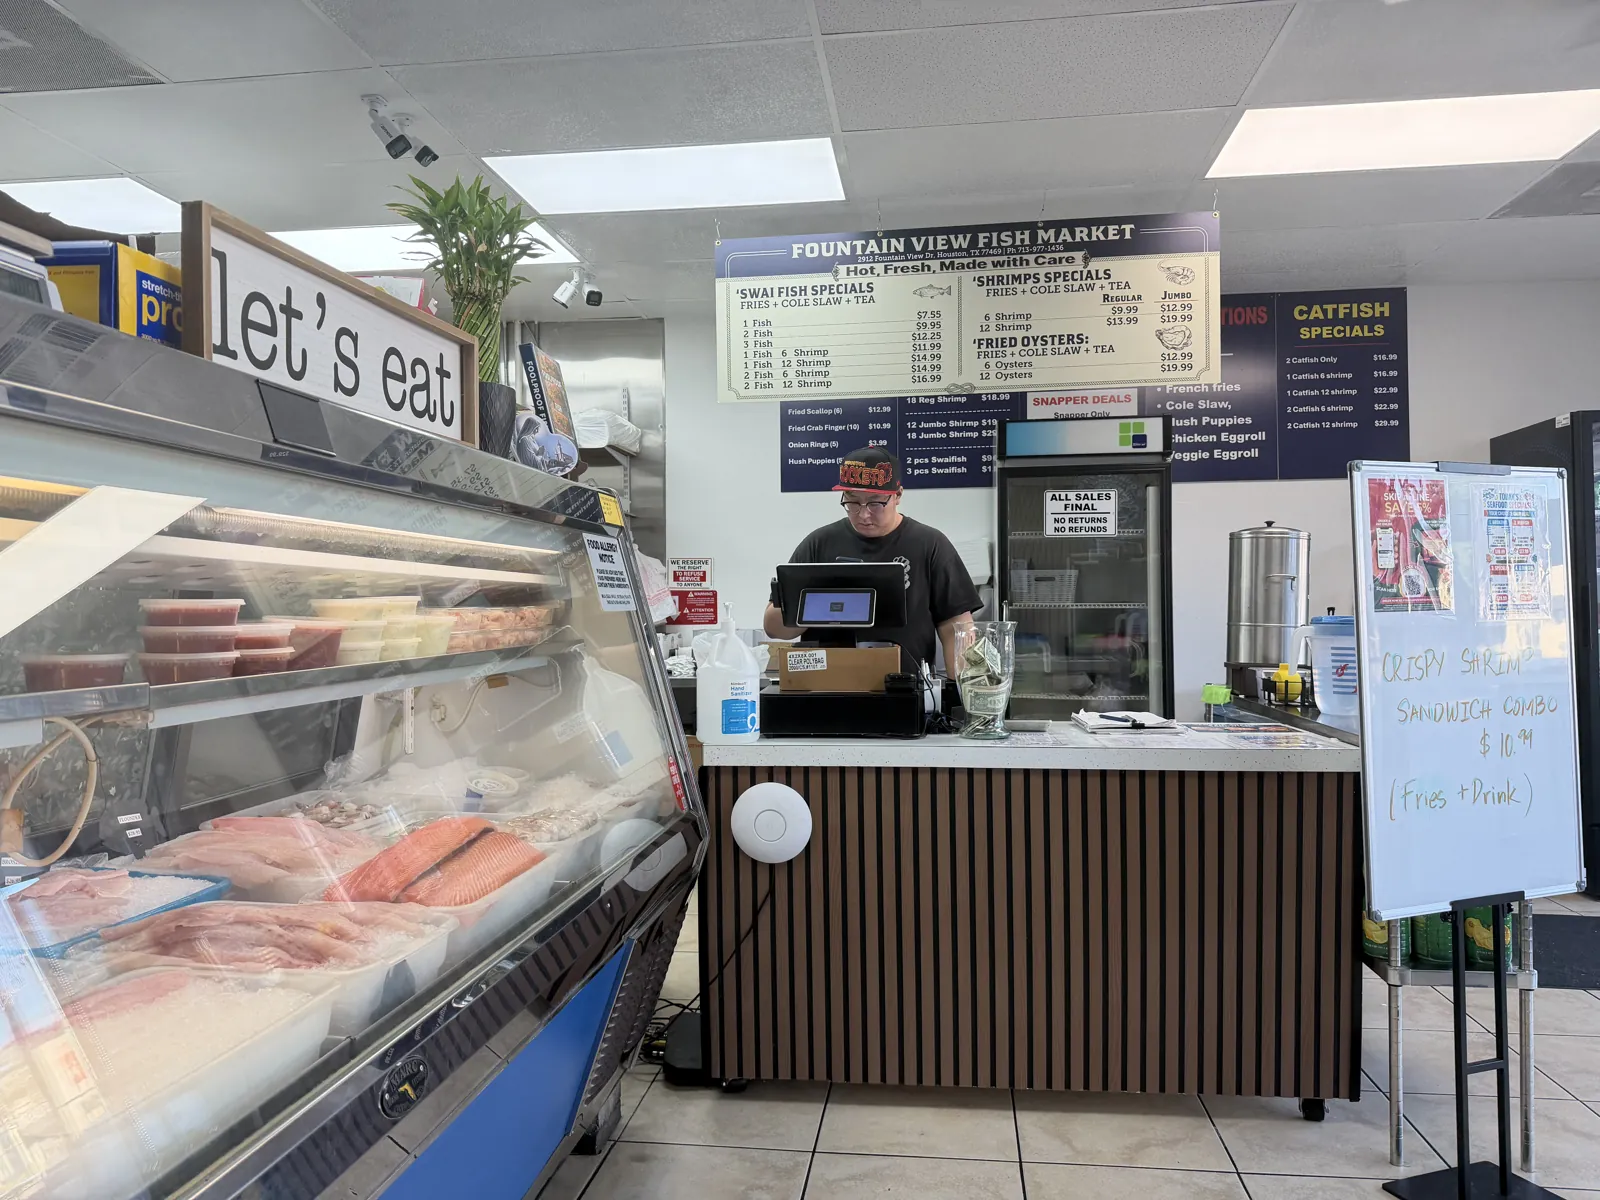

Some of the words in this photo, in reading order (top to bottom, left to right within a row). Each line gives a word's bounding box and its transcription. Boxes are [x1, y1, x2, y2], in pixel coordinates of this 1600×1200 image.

[792, 238, 905, 258] FOUNTAIN
[910, 233, 972, 251] VIEW
[978, 229, 1032, 248] FISH
[1037, 224, 1136, 245] MARKET
[1018, 245, 1064, 253] 713-977-1436
[846, 266, 880, 277] Hot,
[884, 263, 936, 275] Fresh,
[940, 260, 987, 271] Made
[992, 258, 1031, 268] with
[1034, 254, 1076, 266] Care
[1044, 269, 1112, 283] SPECIALS
[778, 286, 807, 298] FISH
[811, 282, 874, 296] SPECIALS
[986, 288, 1018, 298] FRIES
[1030, 285, 1061, 295] COLE
[1064, 284, 1096, 292] SLAW
[1108, 282, 1131, 290] TEA
[741, 301, 769, 309] FRIES
[782, 298, 810, 307] COLE
[813, 297, 842, 306] SLAW
[856, 296, 875, 304] TEA
[753, 319, 772, 327] Fish
[917, 311, 941, 319] $7.55
[995, 312, 1032, 321] Shrimp
[1111, 306, 1138, 315] $9.99
[1160, 303, 1192, 312] $12.99
[1293, 302, 1390, 320] CATFISH
[754, 329, 773, 337] Fish
[916, 321, 941, 330] $9.95
[995, 322, 1032, 332] Shrimp
[1106, 317, 1138, 326] $13.99
[1160, 314, 1192, 323] $19.99
[211, 246, 359, 397] let's
[382, 346, 455, 428] eat
[1300, 324, 1385, 339] SPECIALS
[1022, 333, 1089, 347] OYSTERS:
[754, 350, 772, 358] Fish
[794, 348, 829, 358] Shrimp
[912, 342, 942, 351] $11.99
[977, 350, 1007, 359] FRIES
[1018, 348, 1048, 357] COLE
[1051, 347, 1081, 355] SLAW
[1093, 345, 1115, 353] TEA
[995, 360, 1033, 369] Oysters
[1160, 352, 1193, 362] $12.99
[995, 371, 1033, 381] Oysters
[1160, 363, 1193, 373] $19.99
[526, 361, 544, 410] FOOLPROOF
[754, 381, 774, 390] Fish
[797, 379, 832, 389] Shrimp
[911, 374, 942, 384] $16.99
[1166, 383, 1209, 393] French
[1212, 383, 1241, 392] fries
[919, 396, 935, 405] Reg
[1033, 395, 1092, 406] SNAPPER
[1094, 394, 1132, 404] DEALS
[1166, 401, 1194, 410] Cole
[1197, 400, 1232, 410] Slaw,
[1090, 410, 1110, 418] Only
[1202, 415, 1252, 427] Puppies
[1221, 431, 1266, 443] Eggroll
[1213, 449, 1259, 460] Eggroll
[1382, 648, 1444, 682] CRISPY
[1461, 647, 1534, 676] SHRIMP
[1397, 698, 1492, 724] SANDWICH
[1503, 695, 1558, 716] COMBO
